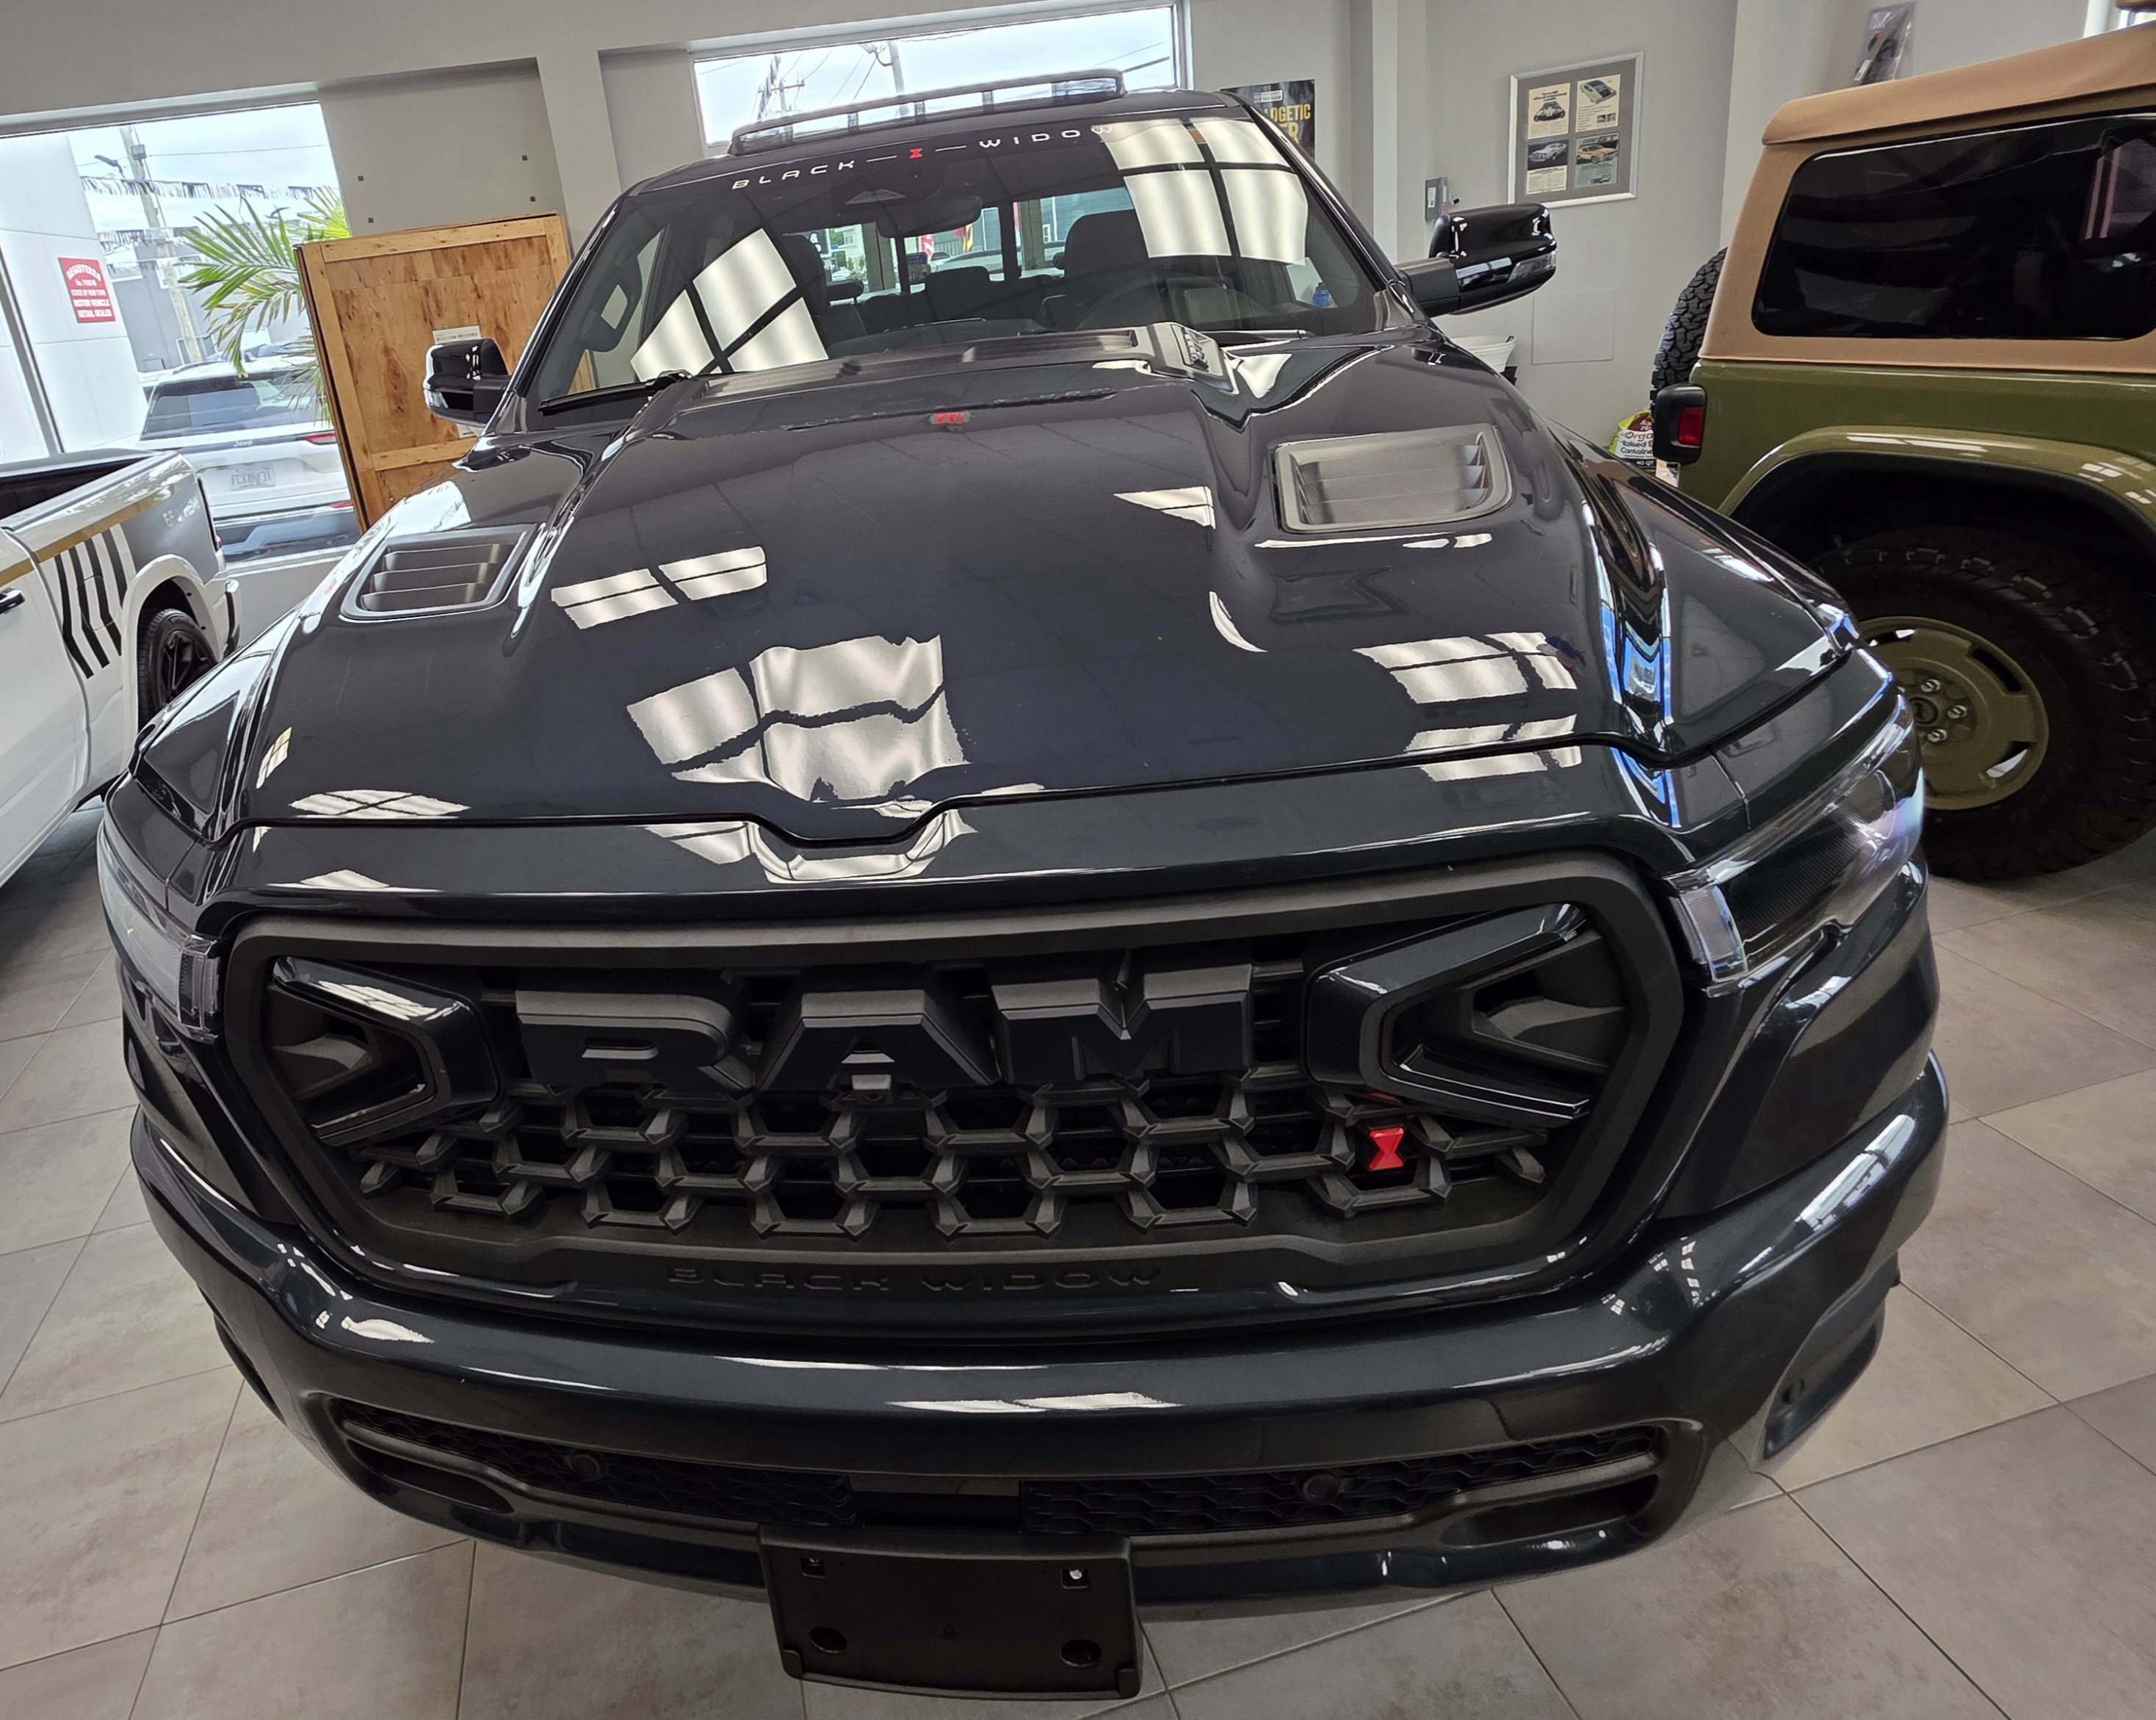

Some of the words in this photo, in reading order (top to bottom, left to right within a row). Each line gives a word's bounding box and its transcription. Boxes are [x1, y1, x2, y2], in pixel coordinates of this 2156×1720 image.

[1265, 104, 1311, 123] OGETIC
[731, 160, 855, 189] BLACK
[979, 124, 1113, 148] WIDOW
[515, 963, 1253, 1091] RAM
[668, 1266, 890, 1291] BLACK
[921, 1265, 1162, 1291] WIDOW
